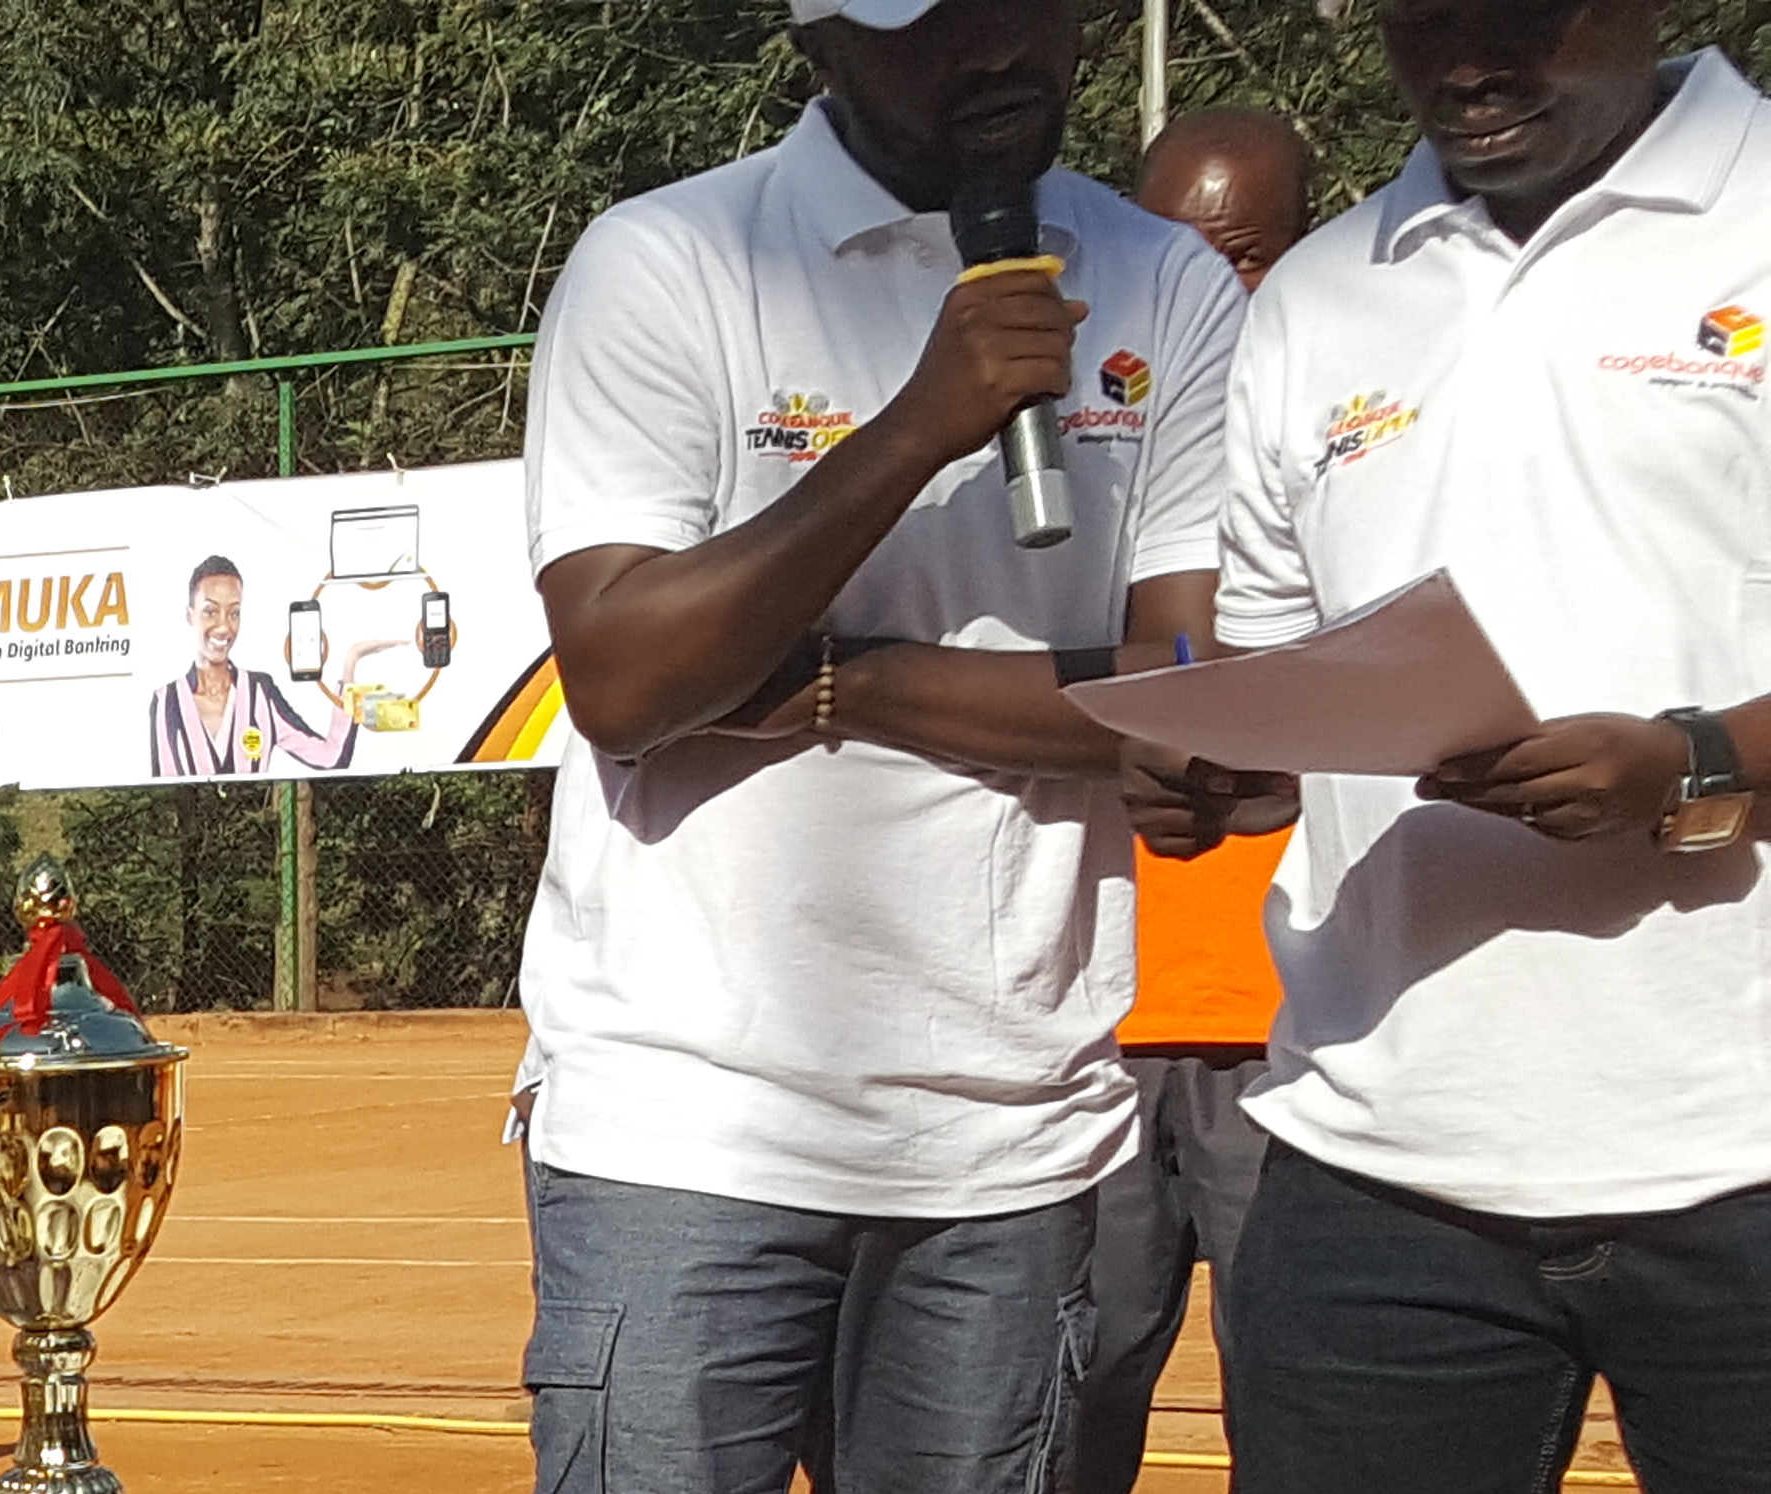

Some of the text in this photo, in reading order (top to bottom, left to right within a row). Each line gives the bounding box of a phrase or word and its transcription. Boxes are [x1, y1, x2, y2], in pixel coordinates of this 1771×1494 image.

[1598, 351, 1765, 384] cogebanque
[8, 636, 61, 662] Digital
[64, 634, 131, 656] Banking
